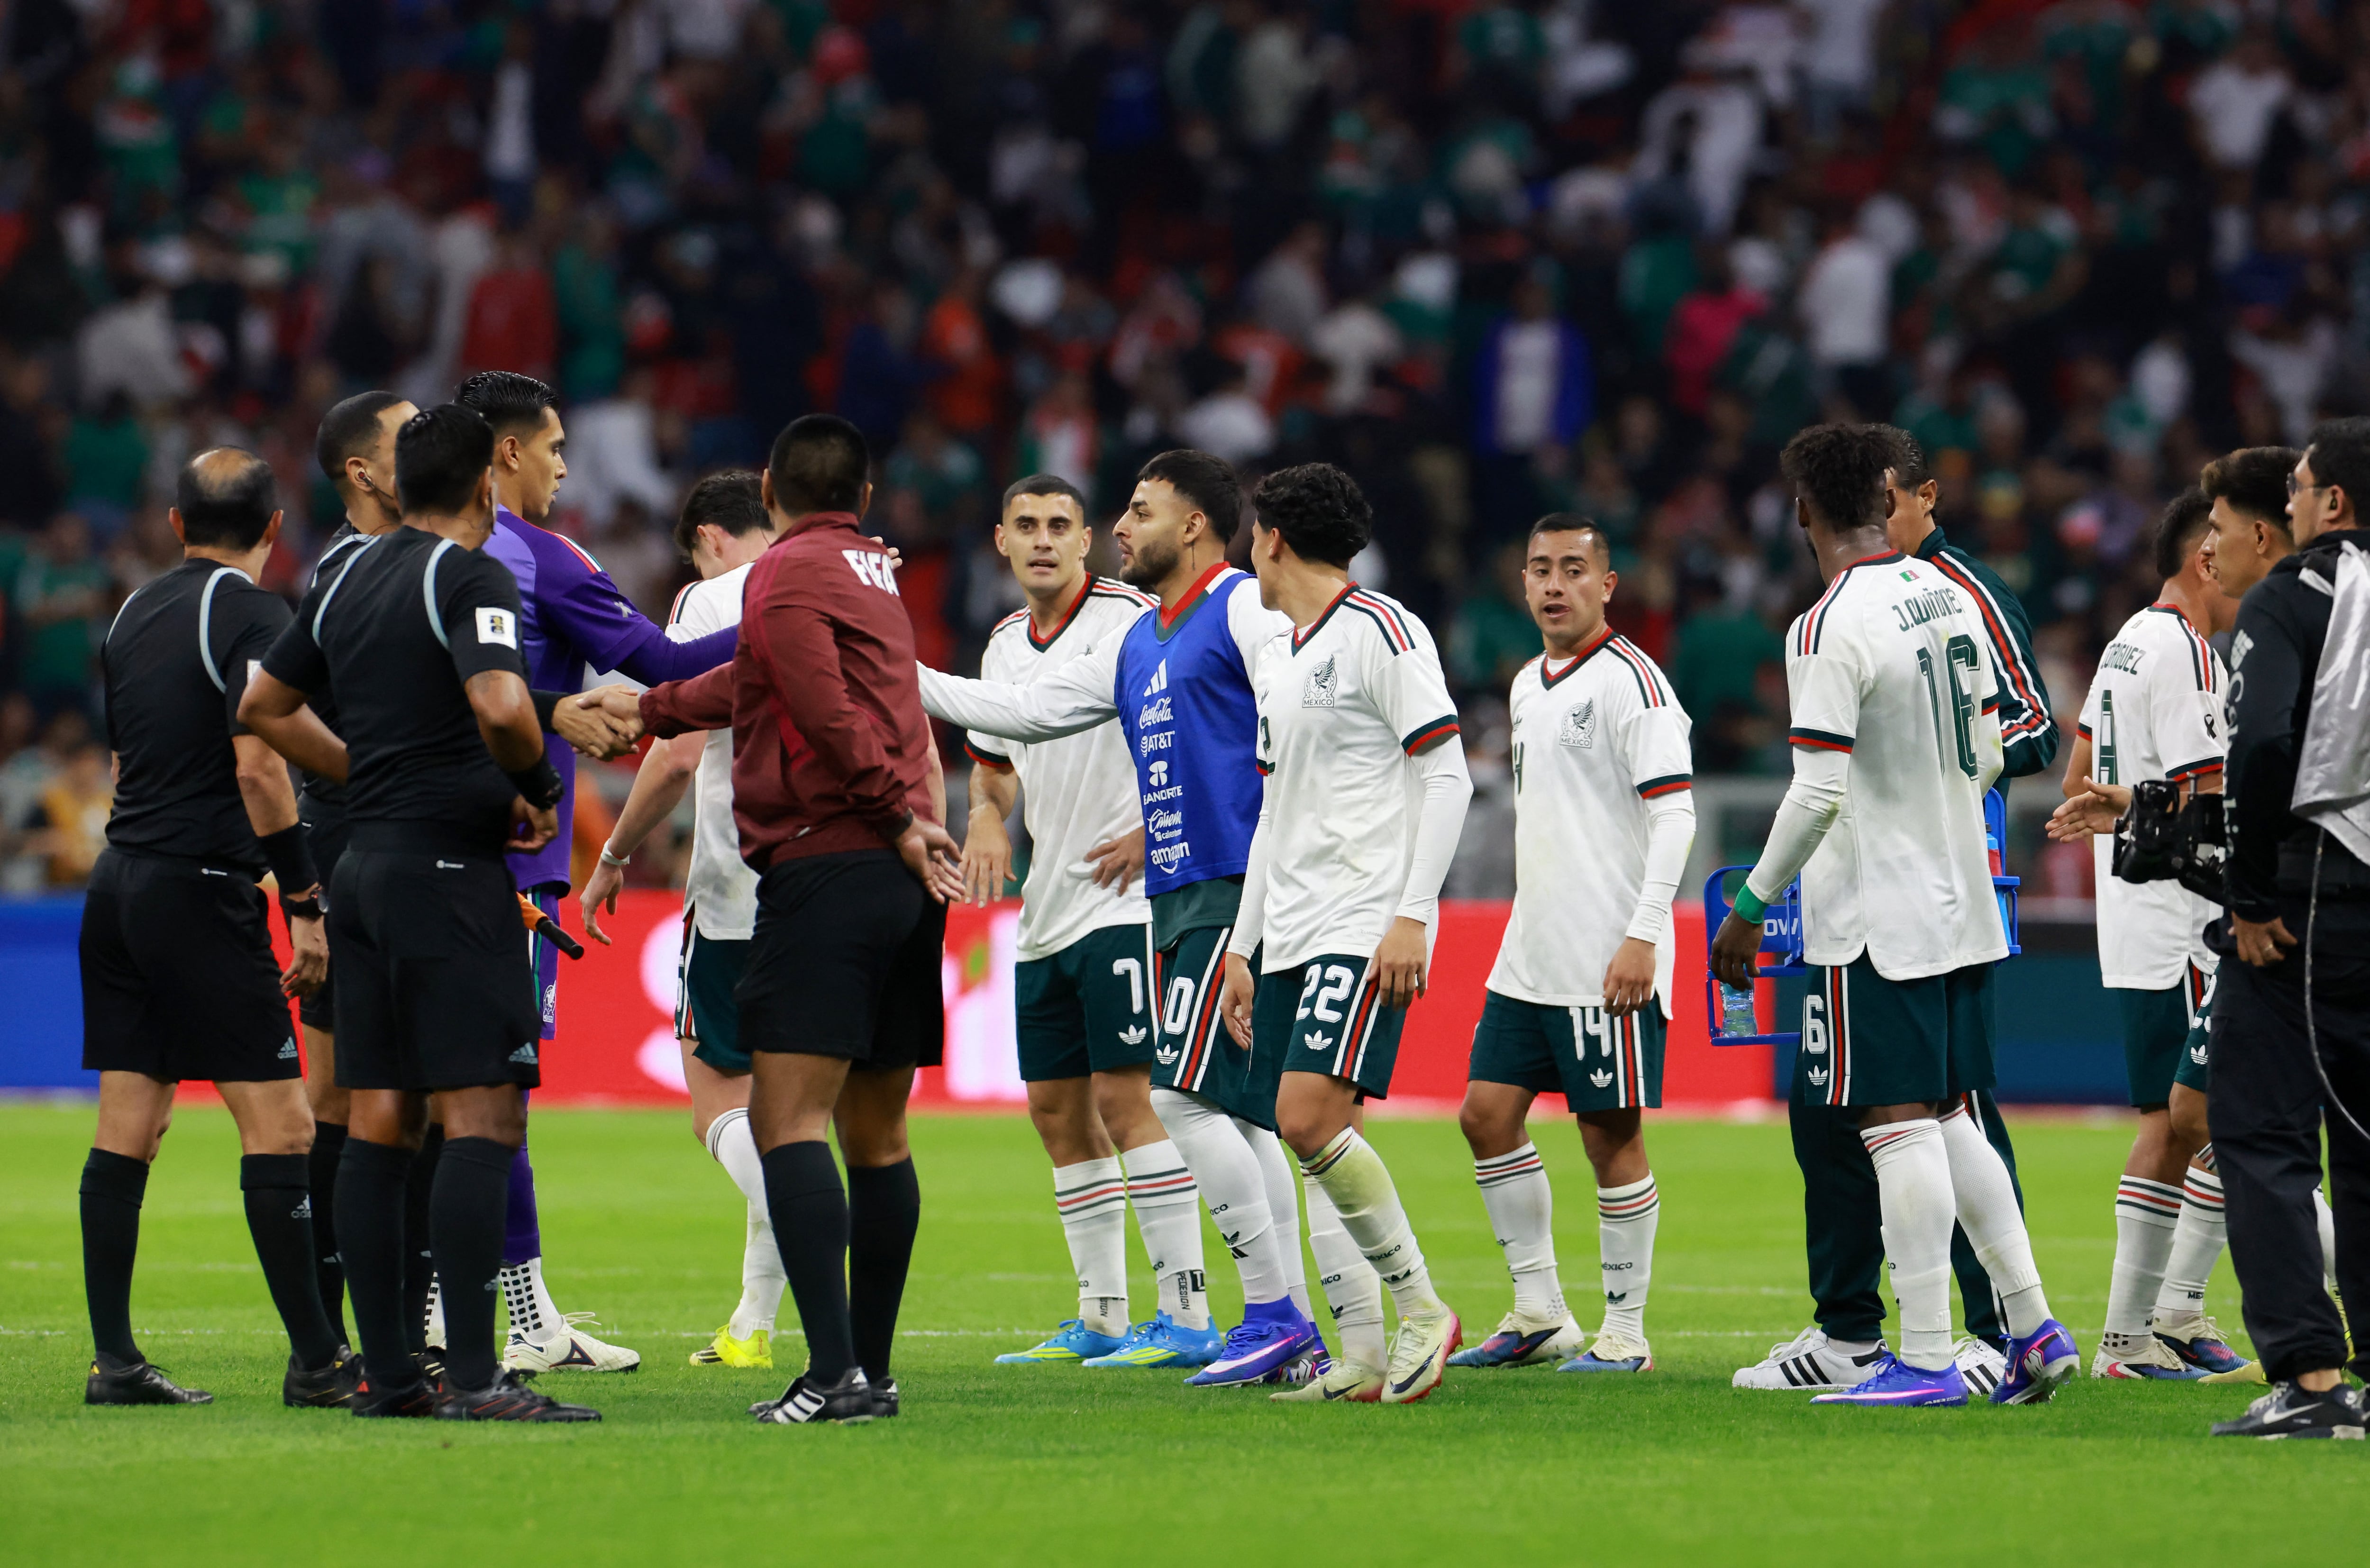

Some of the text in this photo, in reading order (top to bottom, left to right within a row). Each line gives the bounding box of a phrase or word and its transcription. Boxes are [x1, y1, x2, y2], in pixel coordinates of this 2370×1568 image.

[842, 549, 900, 596] FIFA
[1892, 587, 1965, 632] J.QUIÑONE
[1916, 634, 1980, 781] 16
[1148, 731, 1173, 752] AT&T
[1561, 737, 1590, 747] MÉXICO
[1151, 841, 1190, 865] amazon
[1112, 958, 1143, 1014] 7
[1160, 976, 1195, 1034] 0
[1296, 963, 1354, 1023] 22
[1569, 1006, 1612, 1061] 14
[1802, 994, 1828, 1054] 6
